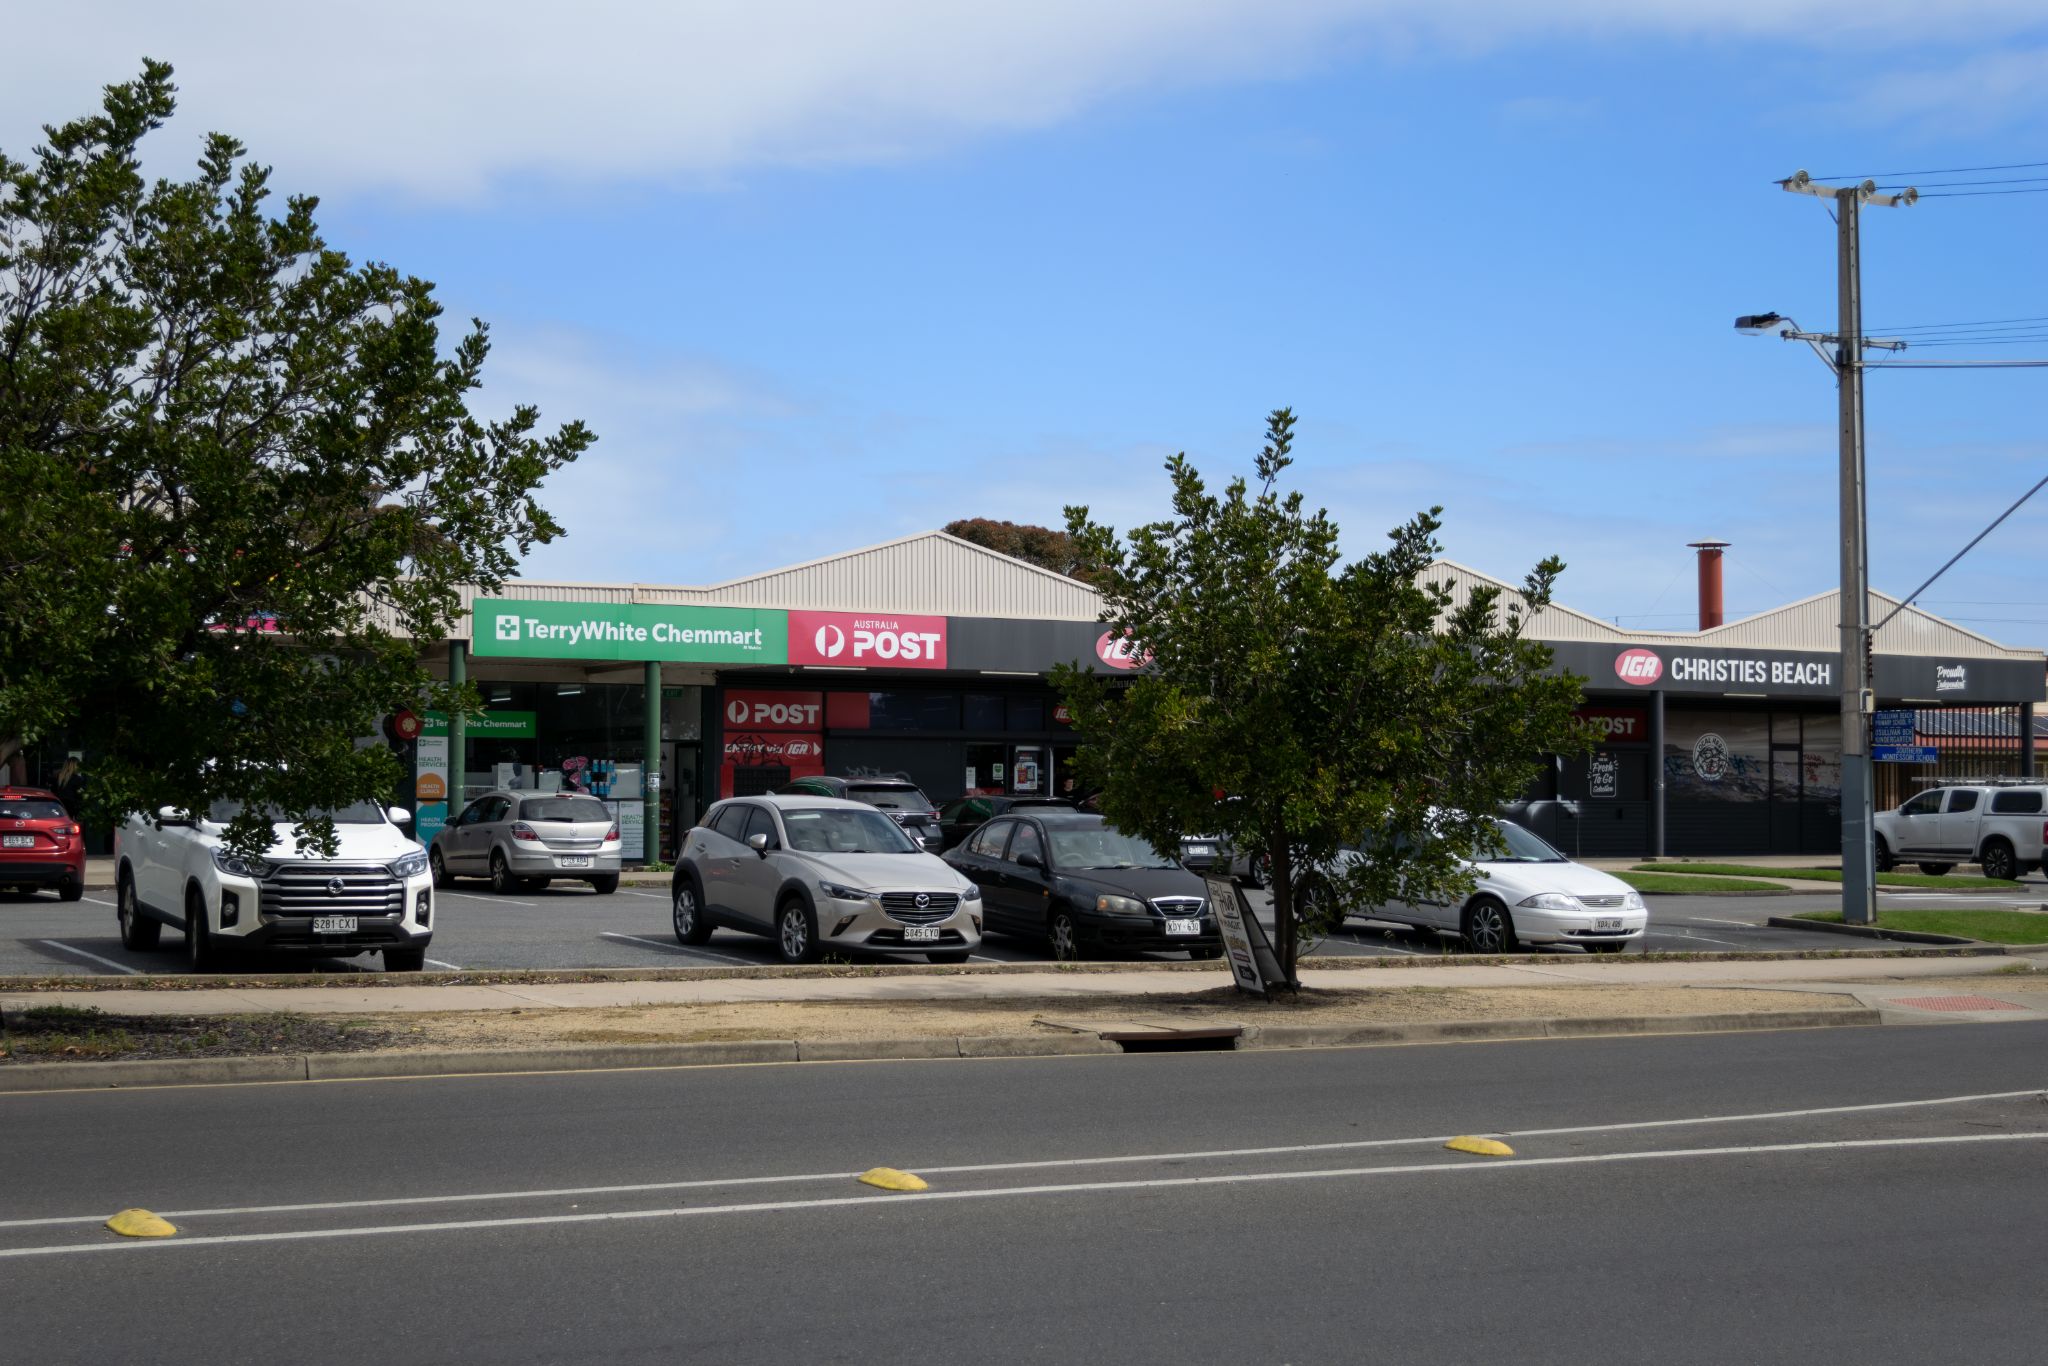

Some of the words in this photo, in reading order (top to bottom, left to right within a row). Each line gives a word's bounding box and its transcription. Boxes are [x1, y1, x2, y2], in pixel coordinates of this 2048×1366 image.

[524, 618, 648, 645] TerryWhite
[652, 623, 762, 646] Chemmart
[853, 619, 899, 630] AUSTRALIA
[853, 630, 941, 660] POST
[1102, 636, 1143, 659] IG
[1620, 655, 1658, 678] IGA
[1671, 657, 1767, 683] CHRISTIES
[1771, 661, 1831, 685] BEACH
[483, 719, 527, 728] Chemmart
[754, 703, 820, 724] POST
[1055, 708, 1070, 719] IG
[787, 743, 809, 755] IGA
